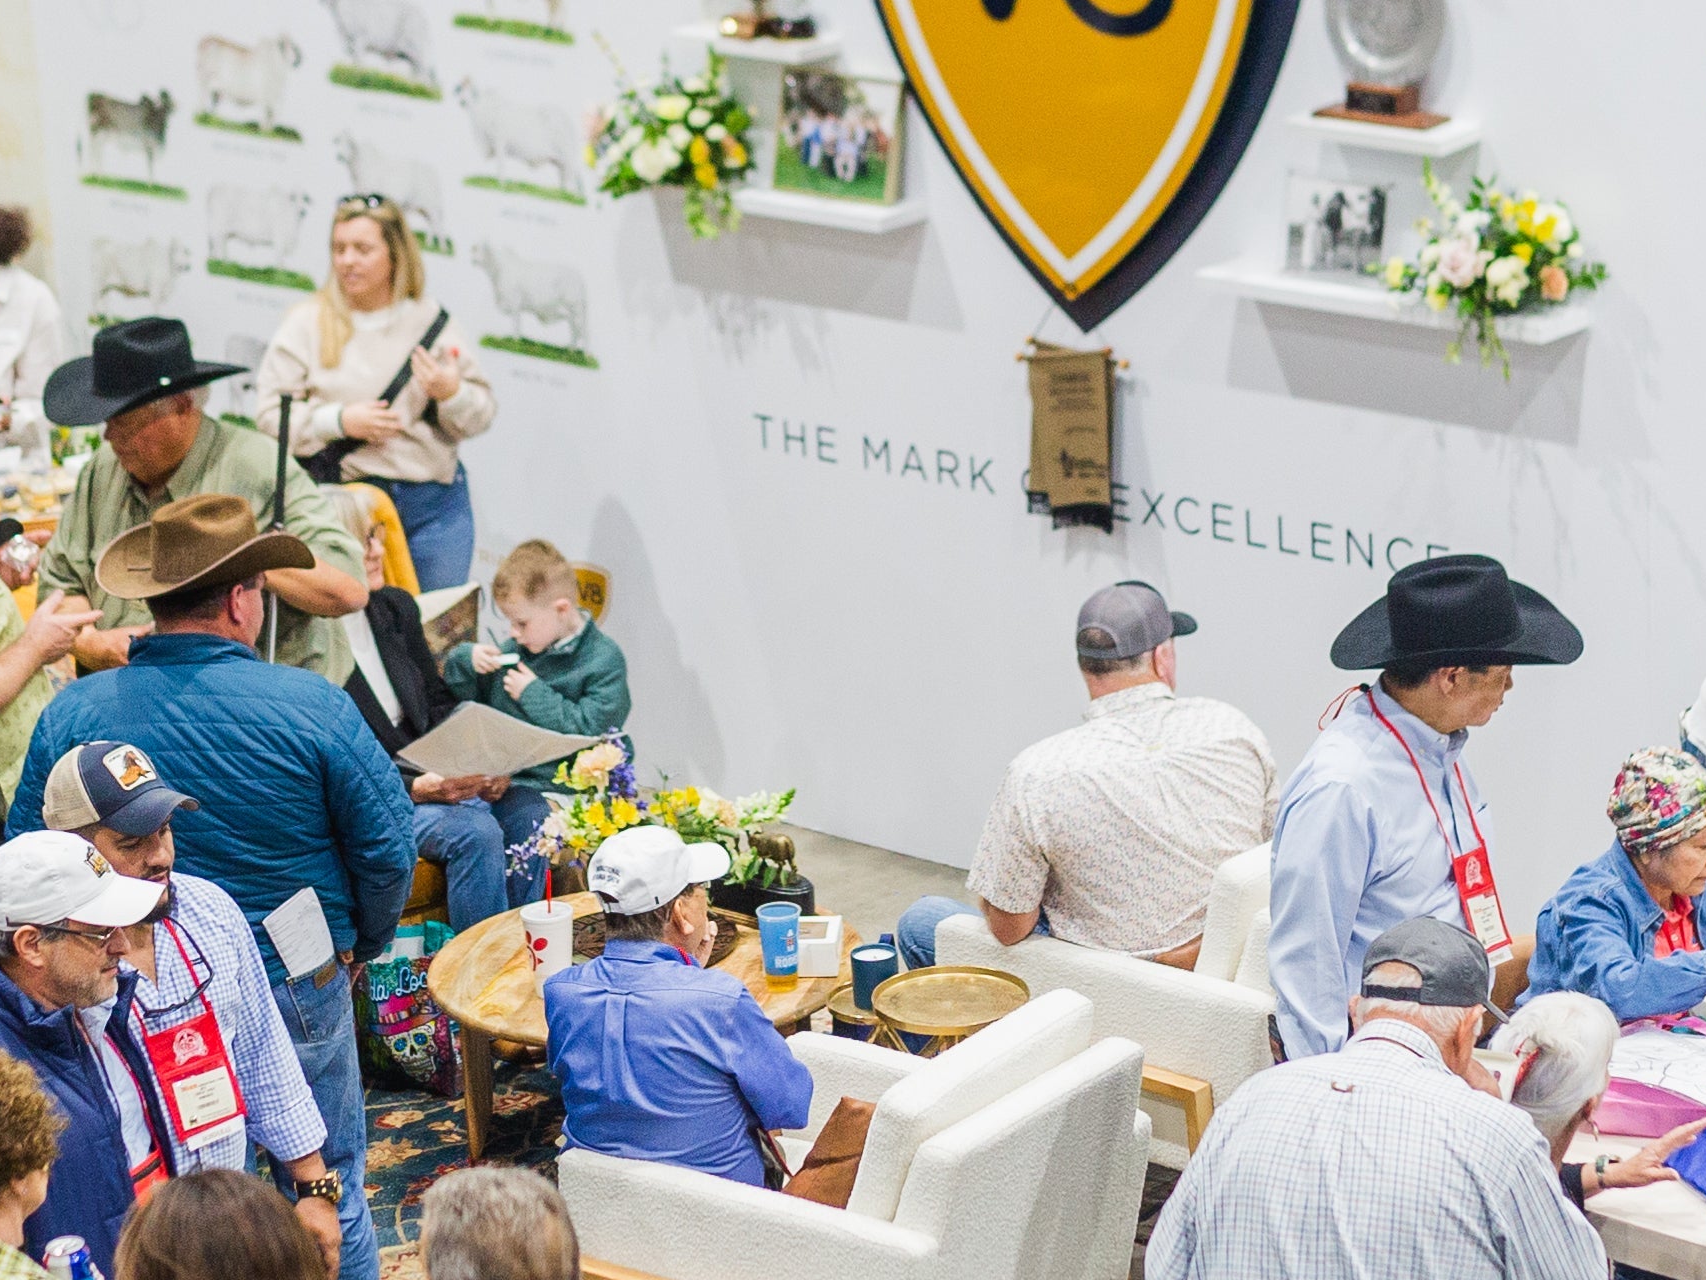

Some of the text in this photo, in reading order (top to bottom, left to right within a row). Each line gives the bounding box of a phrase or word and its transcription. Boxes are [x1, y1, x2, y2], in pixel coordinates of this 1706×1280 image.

[753, 414, 838, 465] THE
[863, 436, 996, 495] MARK
[1110, 483, 1451, 573] EXCELLENC
[577, 582, 604, 605] V8
[370, 966, 428, 1001] da Loc
